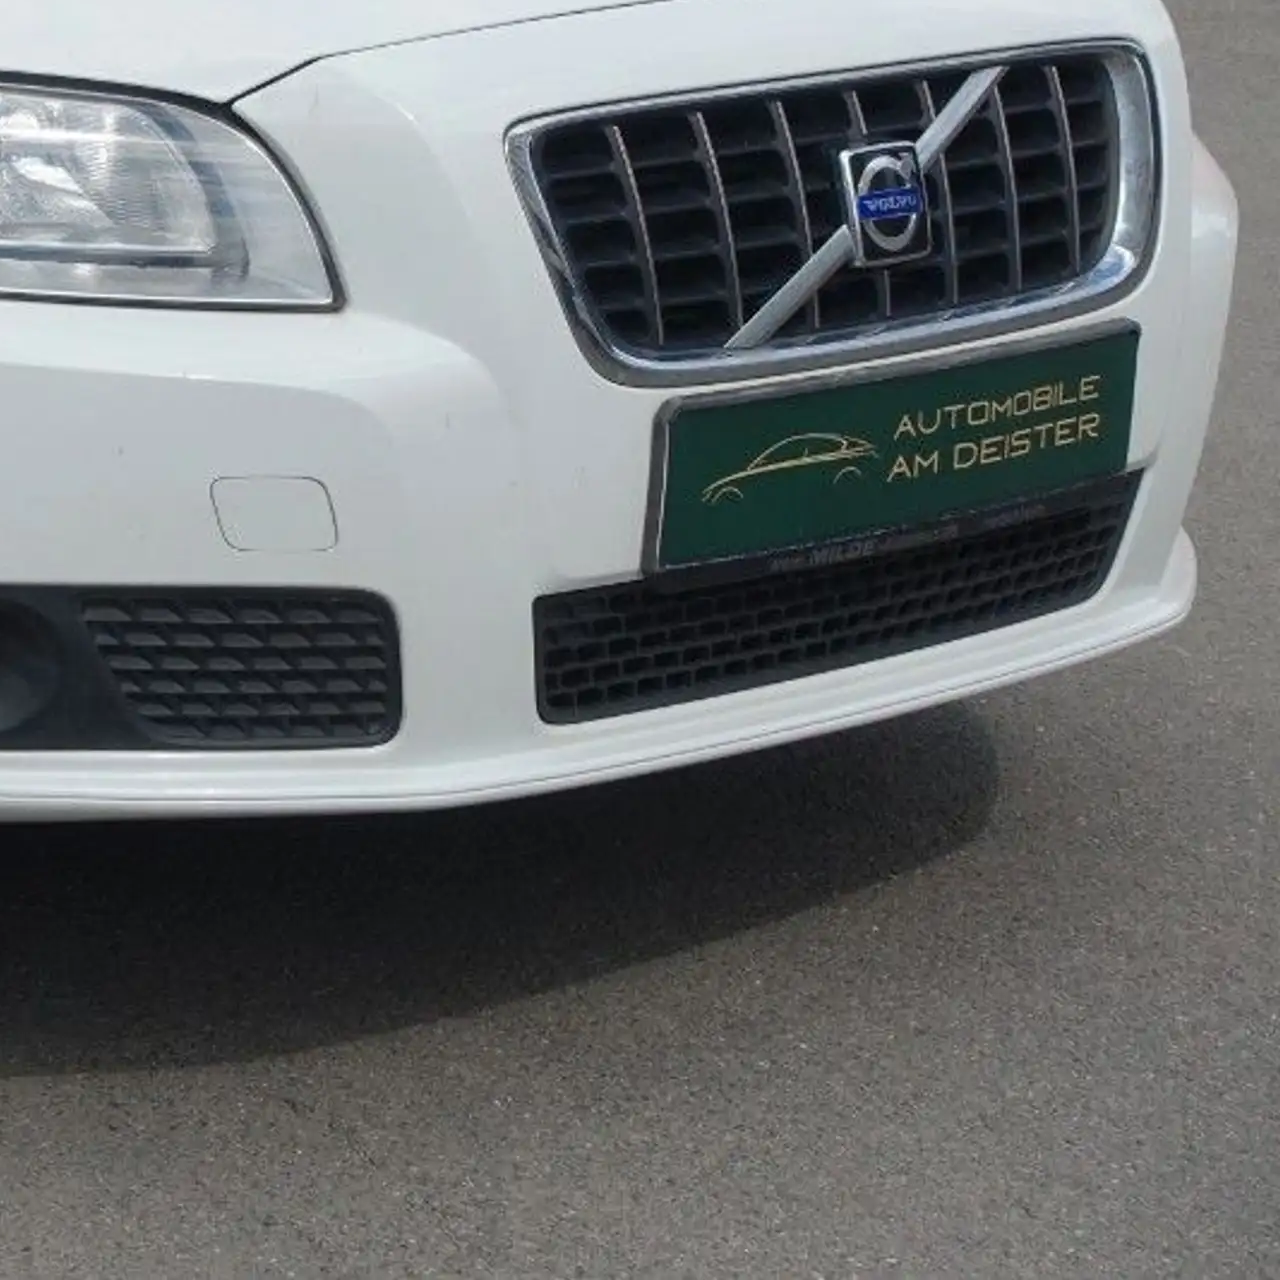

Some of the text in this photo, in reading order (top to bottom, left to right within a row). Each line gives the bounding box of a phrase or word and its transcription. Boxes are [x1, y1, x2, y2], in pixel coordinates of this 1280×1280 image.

[862, 195, 917, 212] VOLVO
[893, 374, 1101, 441] AUTOMOBILE
[886, 413, 1101, 483] AM DEISTER
